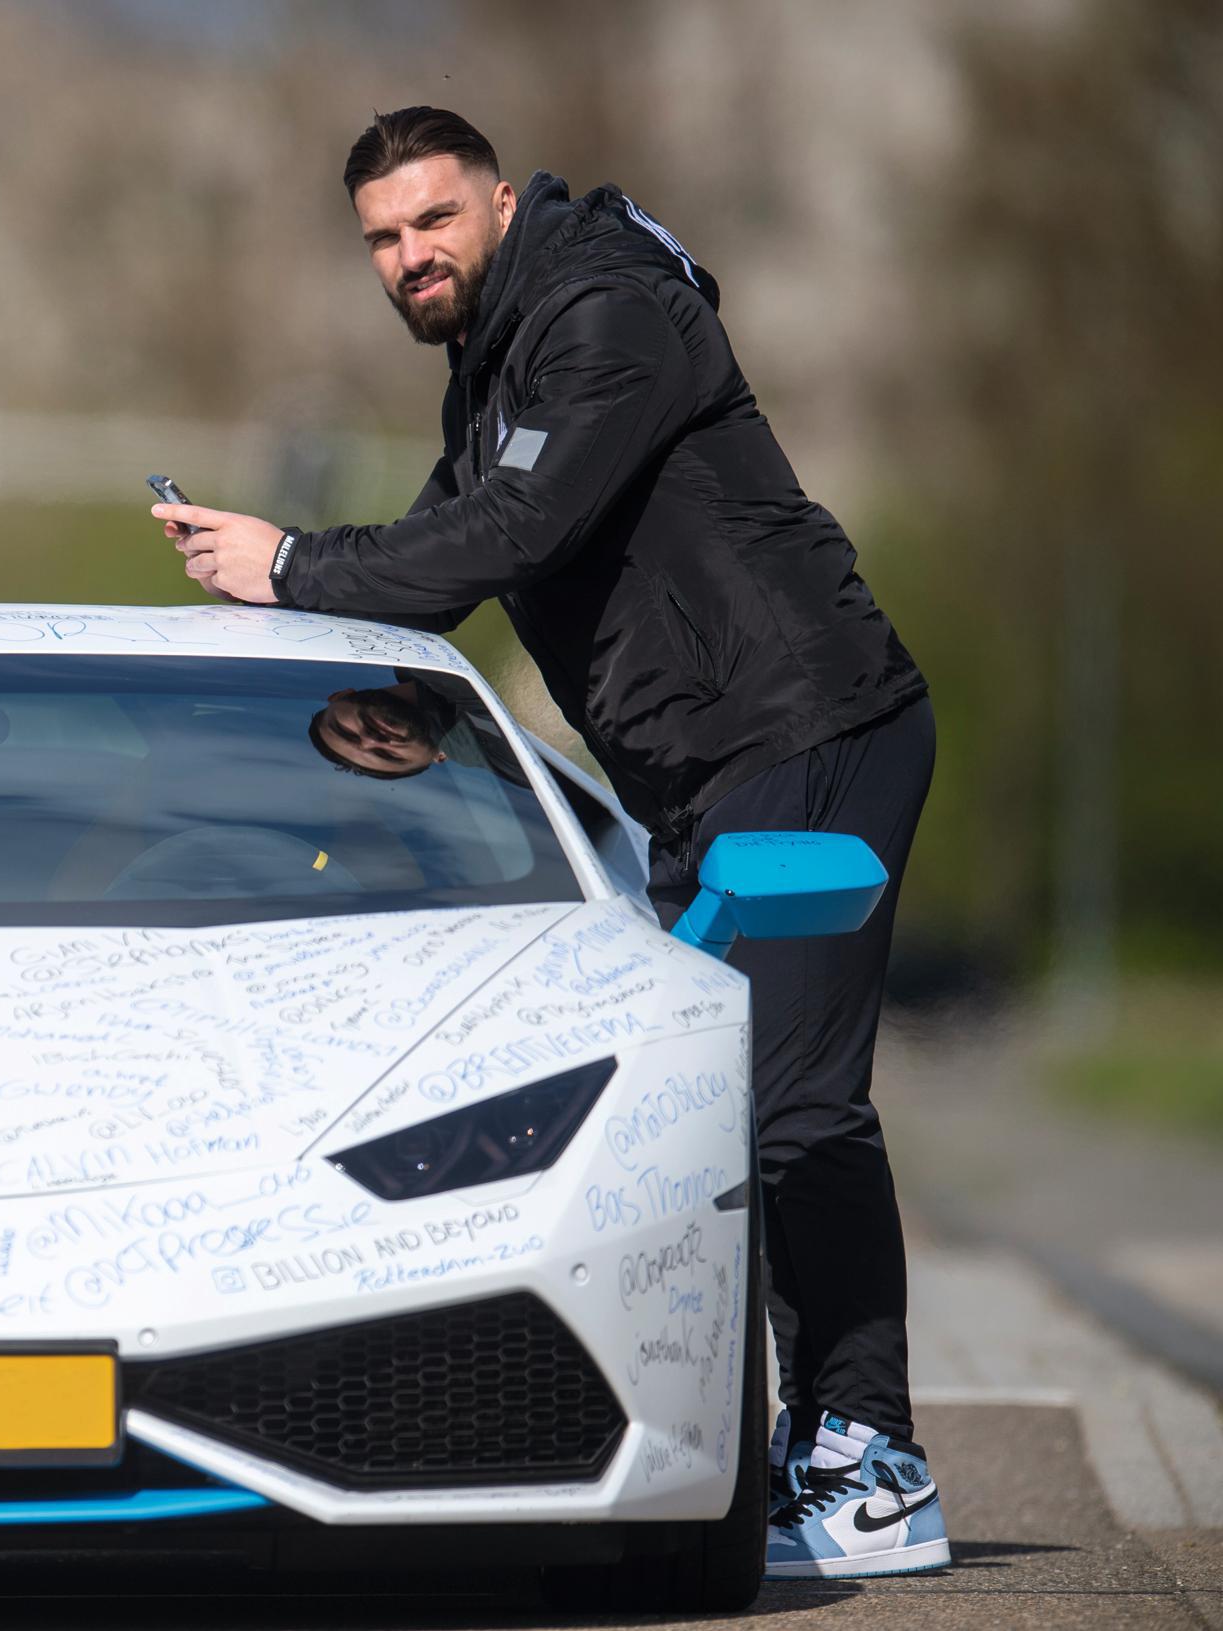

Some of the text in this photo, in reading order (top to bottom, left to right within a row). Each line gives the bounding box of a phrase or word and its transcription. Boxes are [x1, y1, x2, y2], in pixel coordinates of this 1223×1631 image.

[250, 1203, 519, 1291] BILLION AND BEYOND
